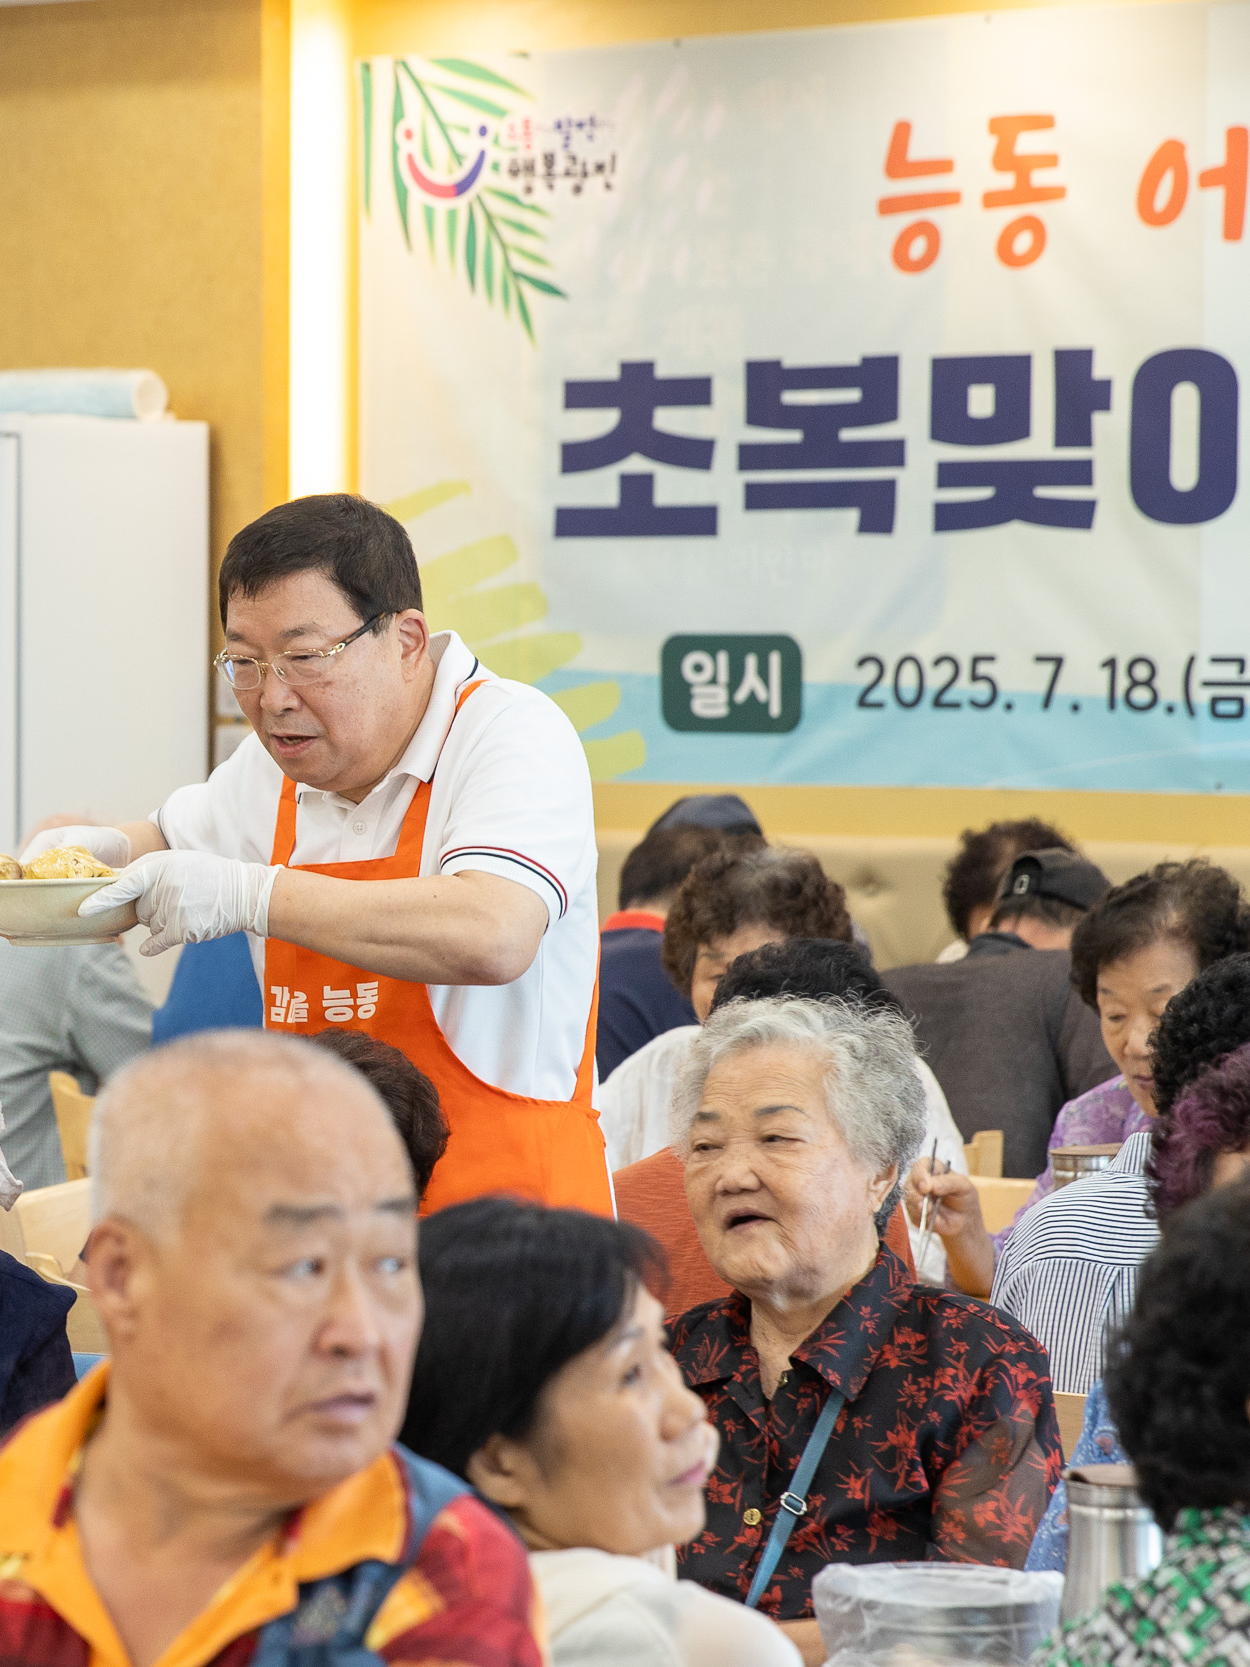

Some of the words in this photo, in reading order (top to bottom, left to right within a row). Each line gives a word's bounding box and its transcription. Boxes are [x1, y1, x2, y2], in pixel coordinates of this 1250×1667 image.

[877, 114, 1067, 274] 능동
[1136, 126, 1249, 242] 어
[680, 650, 783, 719] 일시
[855, 654, 1016, 711] 2025.
[1034, 655, 1083, 712] 7.
[322, 981, 379, 1023] 능동
